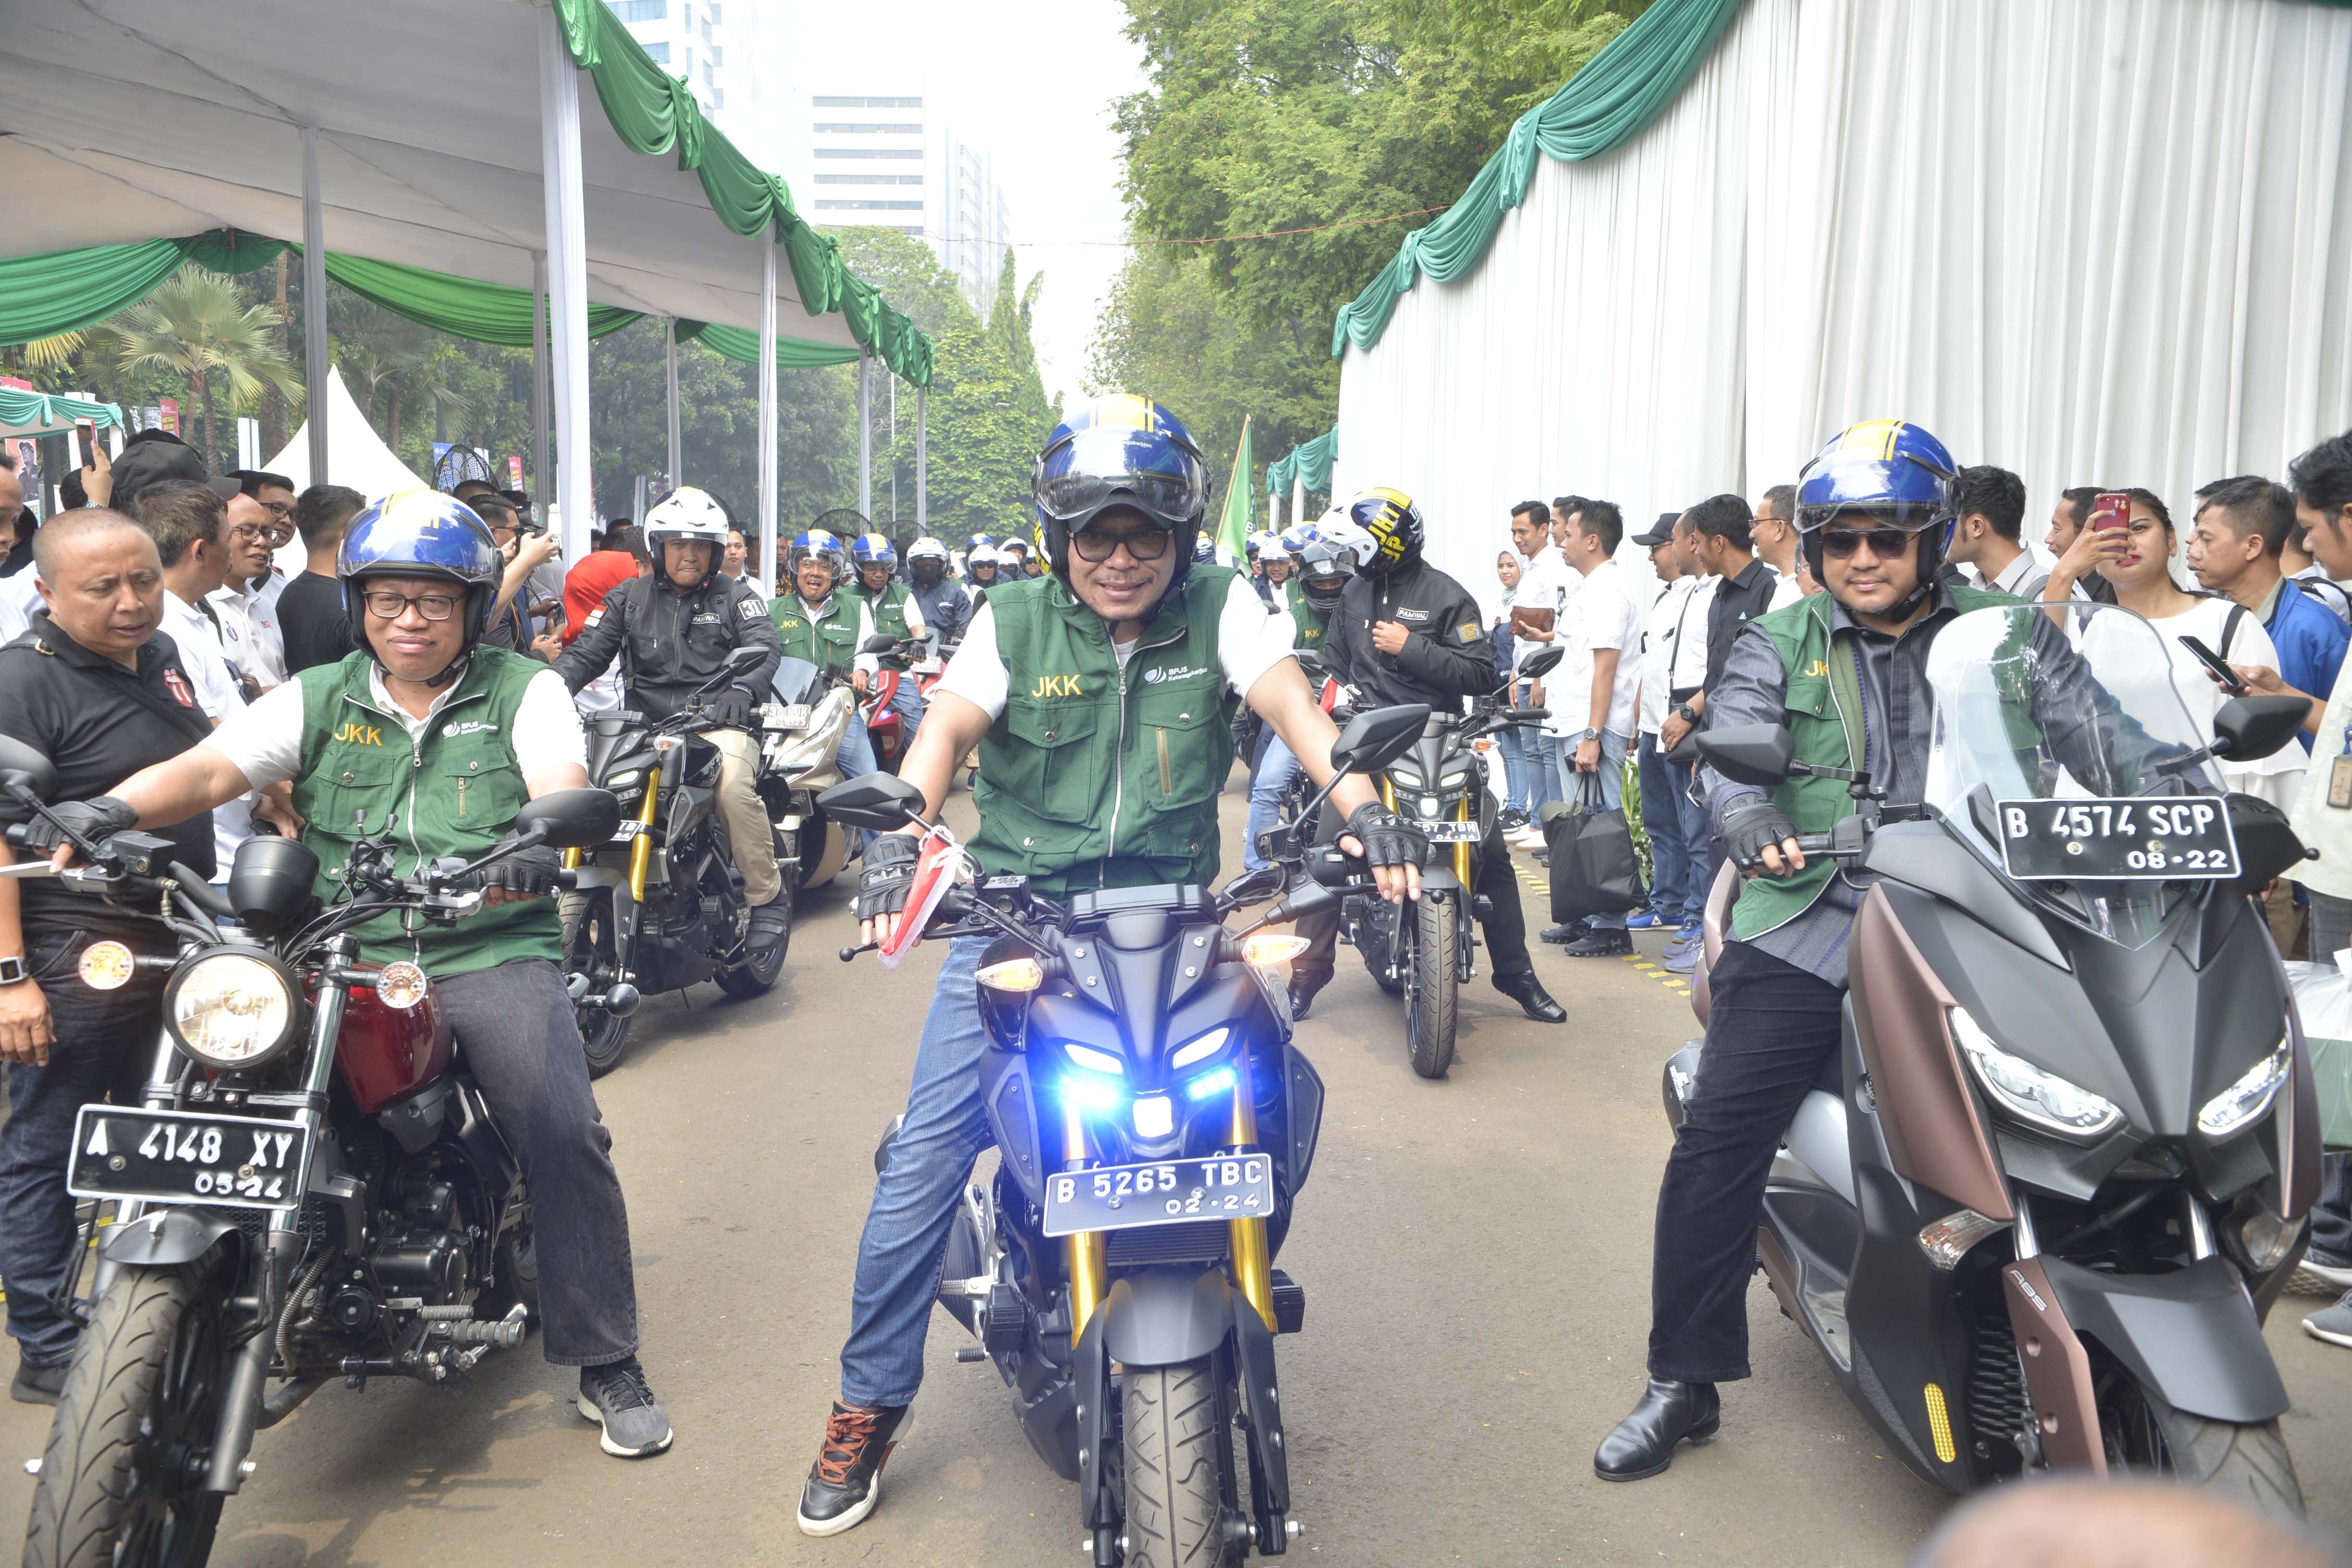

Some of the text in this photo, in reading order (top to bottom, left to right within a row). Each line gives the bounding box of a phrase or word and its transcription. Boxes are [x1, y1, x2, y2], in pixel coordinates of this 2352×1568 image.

[1368, 502, 1400, 545] JHT
[742, 601, 762, 616] 31
[1399, 609, 1426, 619] PAMWAL
[780, 619, 798, 629] JKK
[1305, 629, 1319, 638] JKK
[1168, 666, 1187, 676] BPJS
[1032, 674, 1083, 697] JKK
[334, 723, 383, 746] JKK
[1417, 823, 1439, 832] 57
[2006, 804, 2214, 838] B 4574 SCP
[85, 1119, 293, 1168] A 4148 XY
[1057, 1160, 1263, 1203] B 5265 TBC
[2010, 1269, 2047, 1311] ABS
